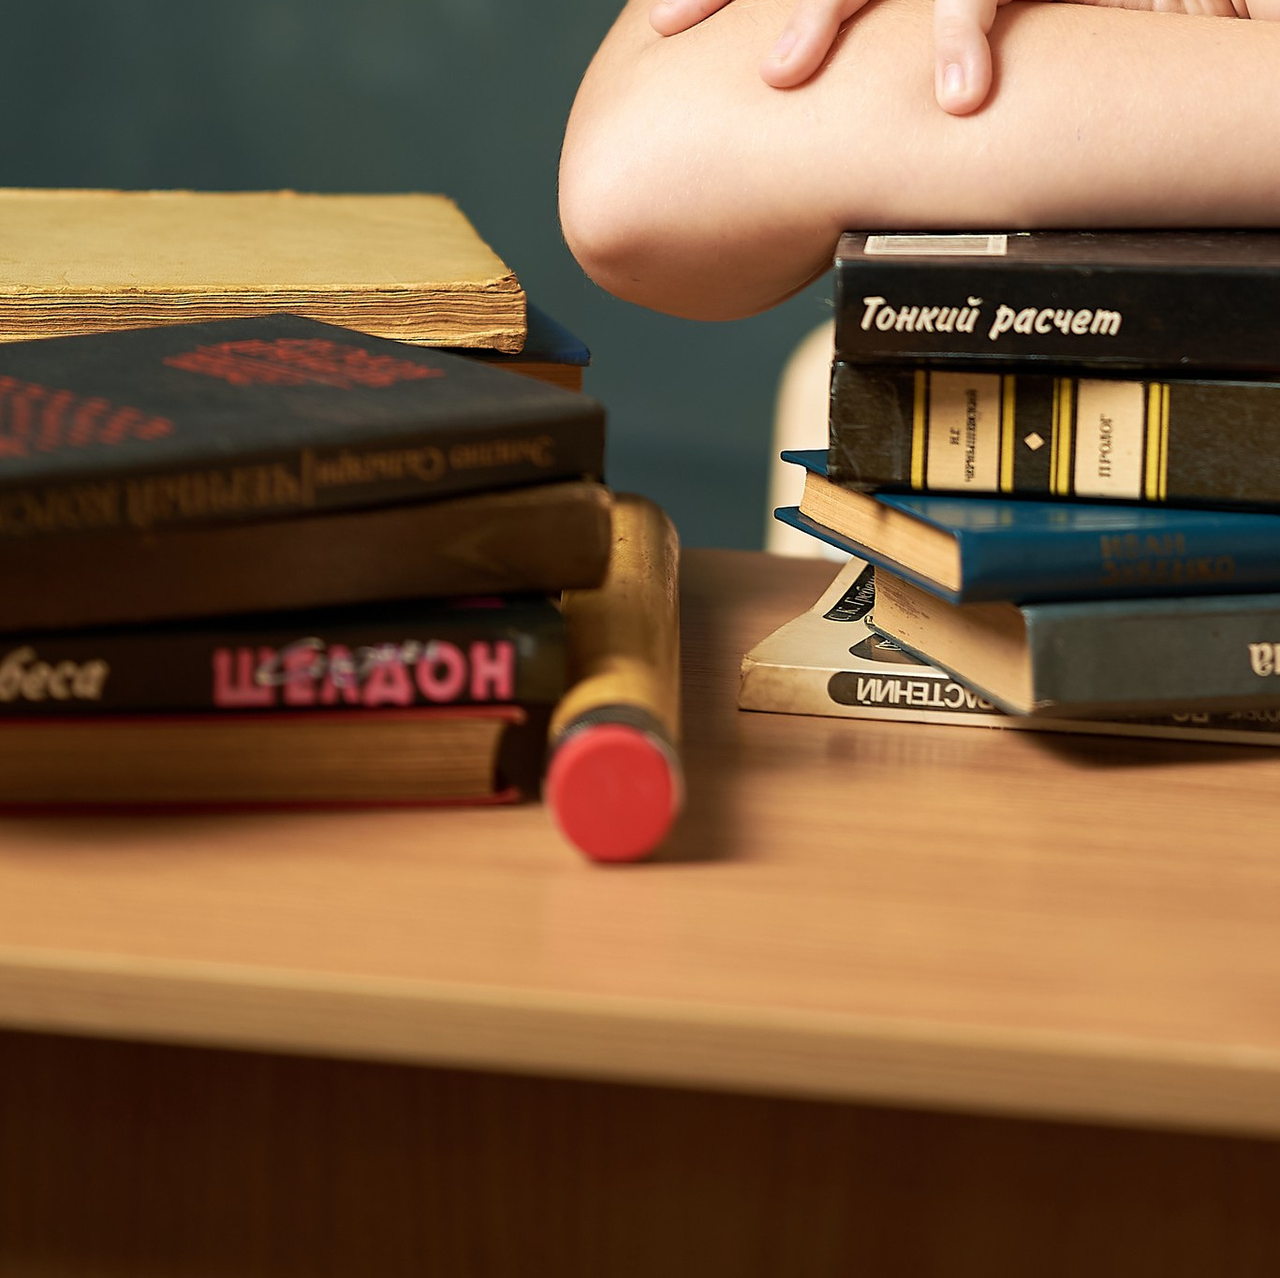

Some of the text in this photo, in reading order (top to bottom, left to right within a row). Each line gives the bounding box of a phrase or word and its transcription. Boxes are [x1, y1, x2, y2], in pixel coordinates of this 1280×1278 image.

[859, 295, 1123, 341] Тонкий расчет
[1097, 413, 1113, 479] ПРОЛОГ
[212, 640, 517, 708] ШЕЛДОН
